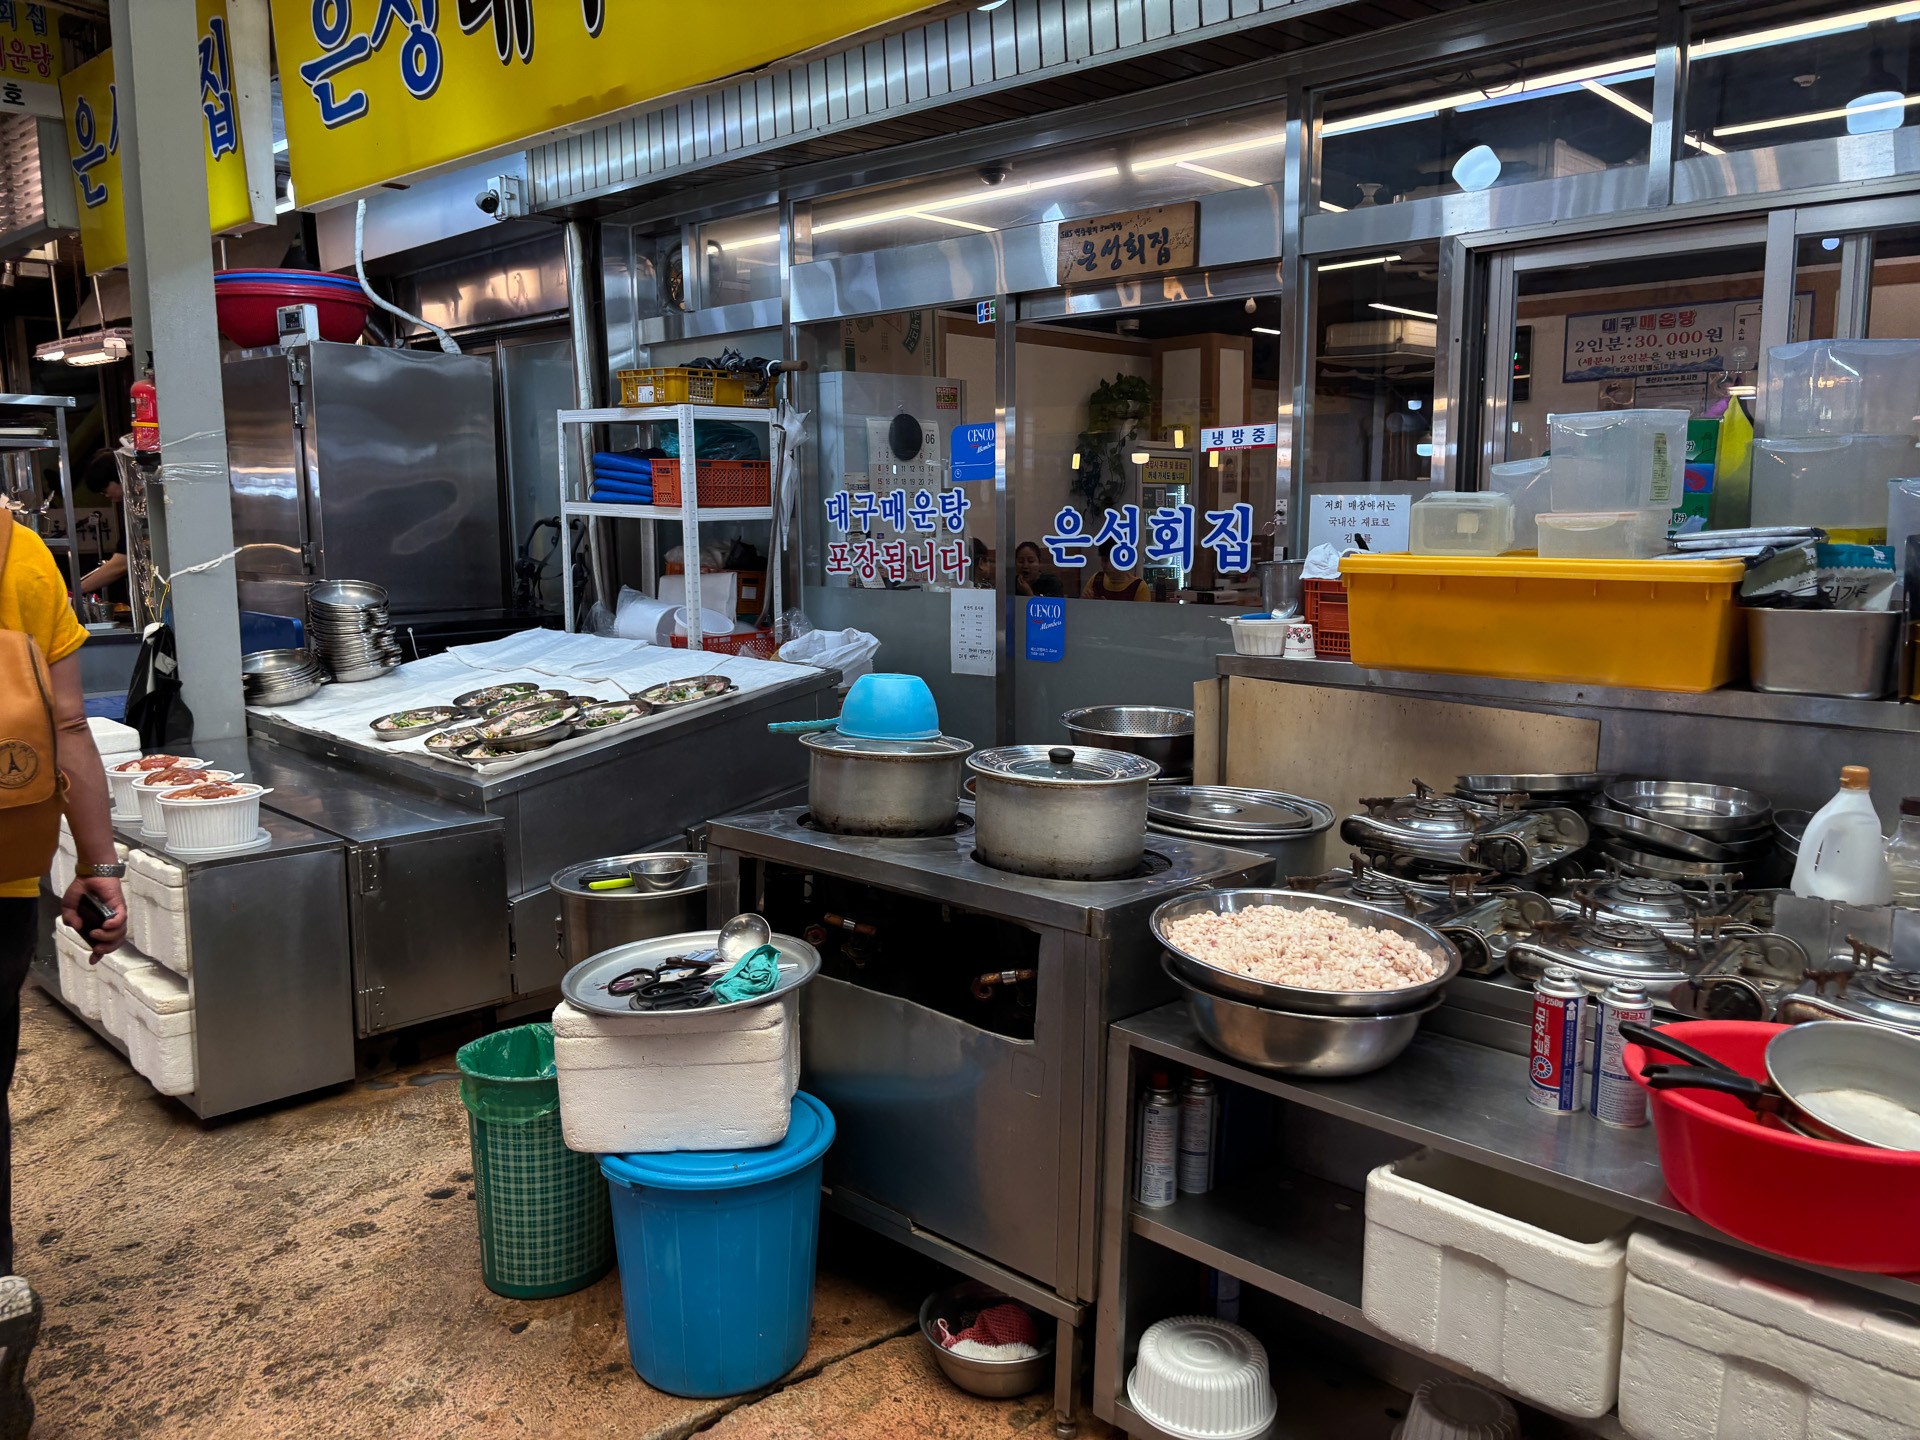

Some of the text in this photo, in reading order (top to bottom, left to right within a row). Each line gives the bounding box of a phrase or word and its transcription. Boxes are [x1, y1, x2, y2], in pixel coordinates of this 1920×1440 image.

[3, 83, 25, 106] 호
[1077, 227, 1171, 272] 은성회집
[978, 305, 996, 317] JCB
[925, 434, 935, 444] 06
[968, 428, 994, 442] CESCO
[826, 488, 970, 532] 대구매운탕
[1324, 500, 1396, 511] 저희 매장에서는
[1328, 516, 1390, 527] 국내산 재료로
[1043, 504, 1253, 573] 은성회집
[1344, 533, 1372, 544] 김를
[826, 539, 972, 584] 포장됩니다
[1030, 603, 1061, 618] CESCO
[1610, 1008, 1646, 1020] 가열금지
